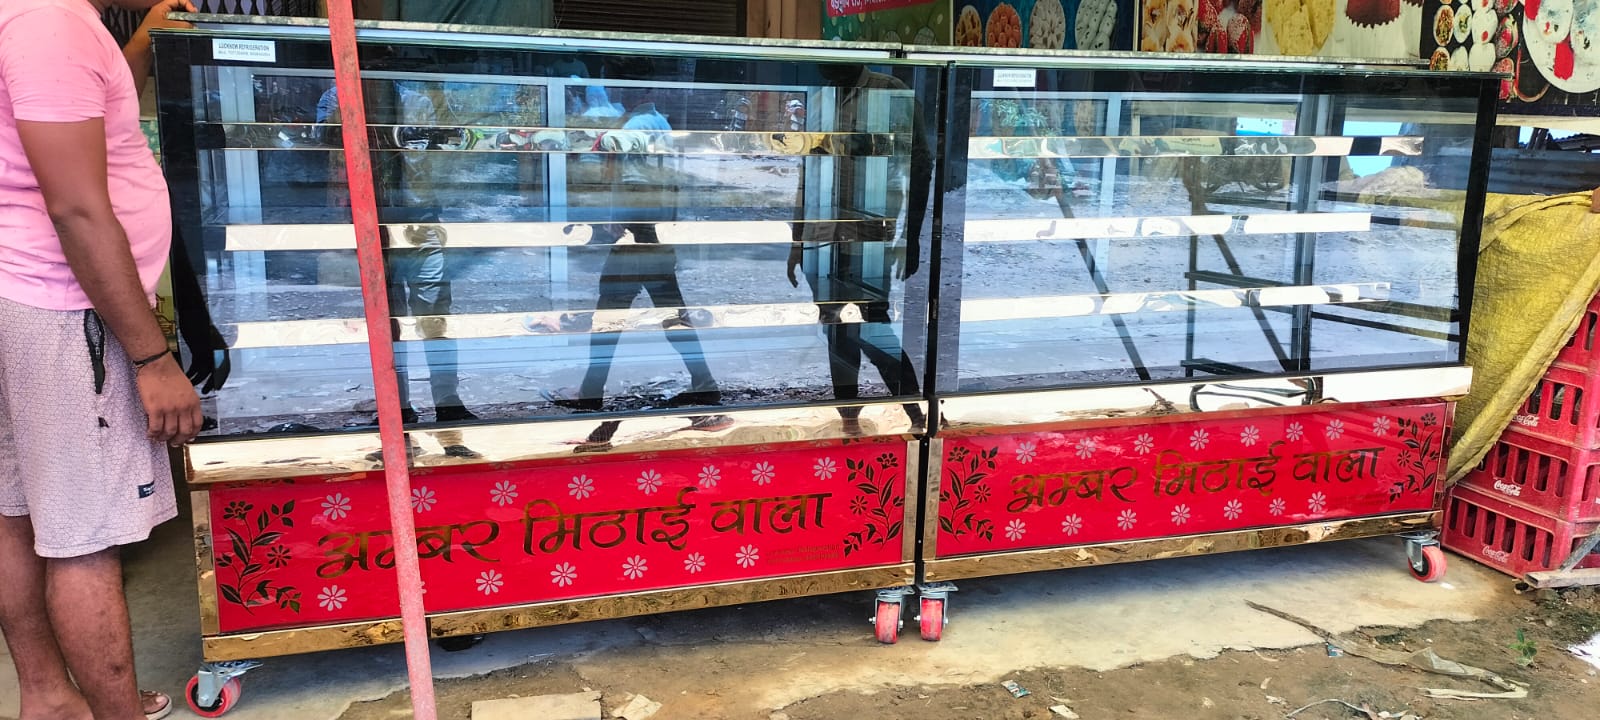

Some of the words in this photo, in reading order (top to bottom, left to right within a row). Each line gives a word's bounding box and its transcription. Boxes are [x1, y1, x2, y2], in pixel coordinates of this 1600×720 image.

[1006, 465, 1137, 513] अम्बर
[1152, 440, 1287, 497] मिठाई
[1292, 446, 1386, 483] वाला
[520, 486, 698, 555] मिठाई
[710, 492, 833, 536] वाला
